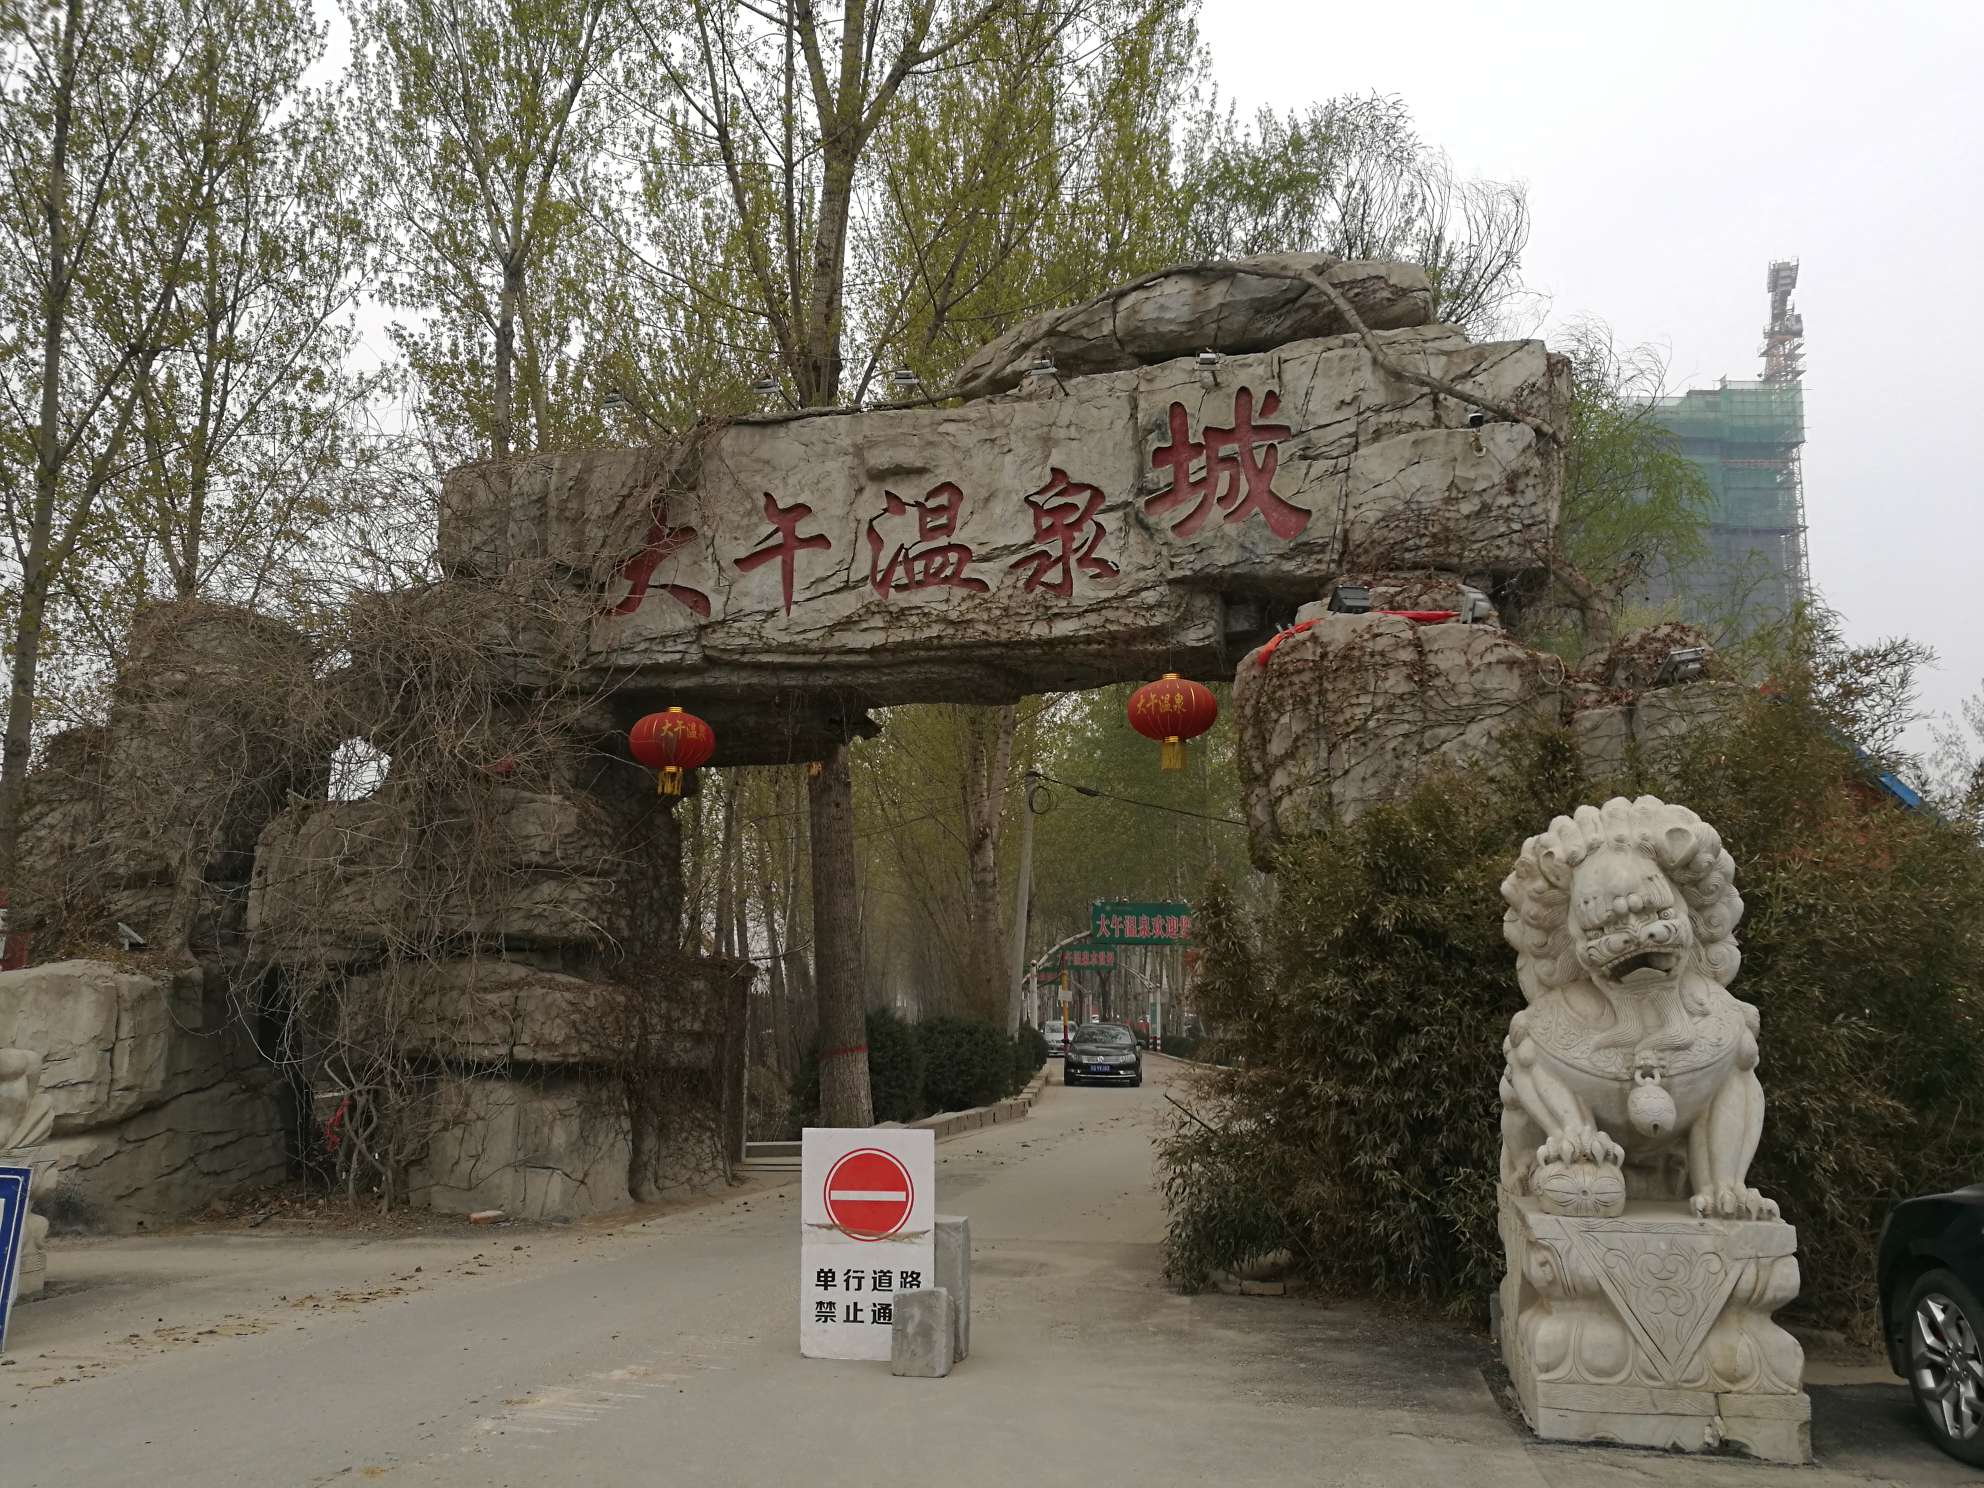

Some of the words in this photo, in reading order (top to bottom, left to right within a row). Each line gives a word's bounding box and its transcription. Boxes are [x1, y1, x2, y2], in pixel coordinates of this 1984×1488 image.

[602, 386, 1312, 617] 大午温泉城
[815, 1268, 922, 1292] 单行道路
